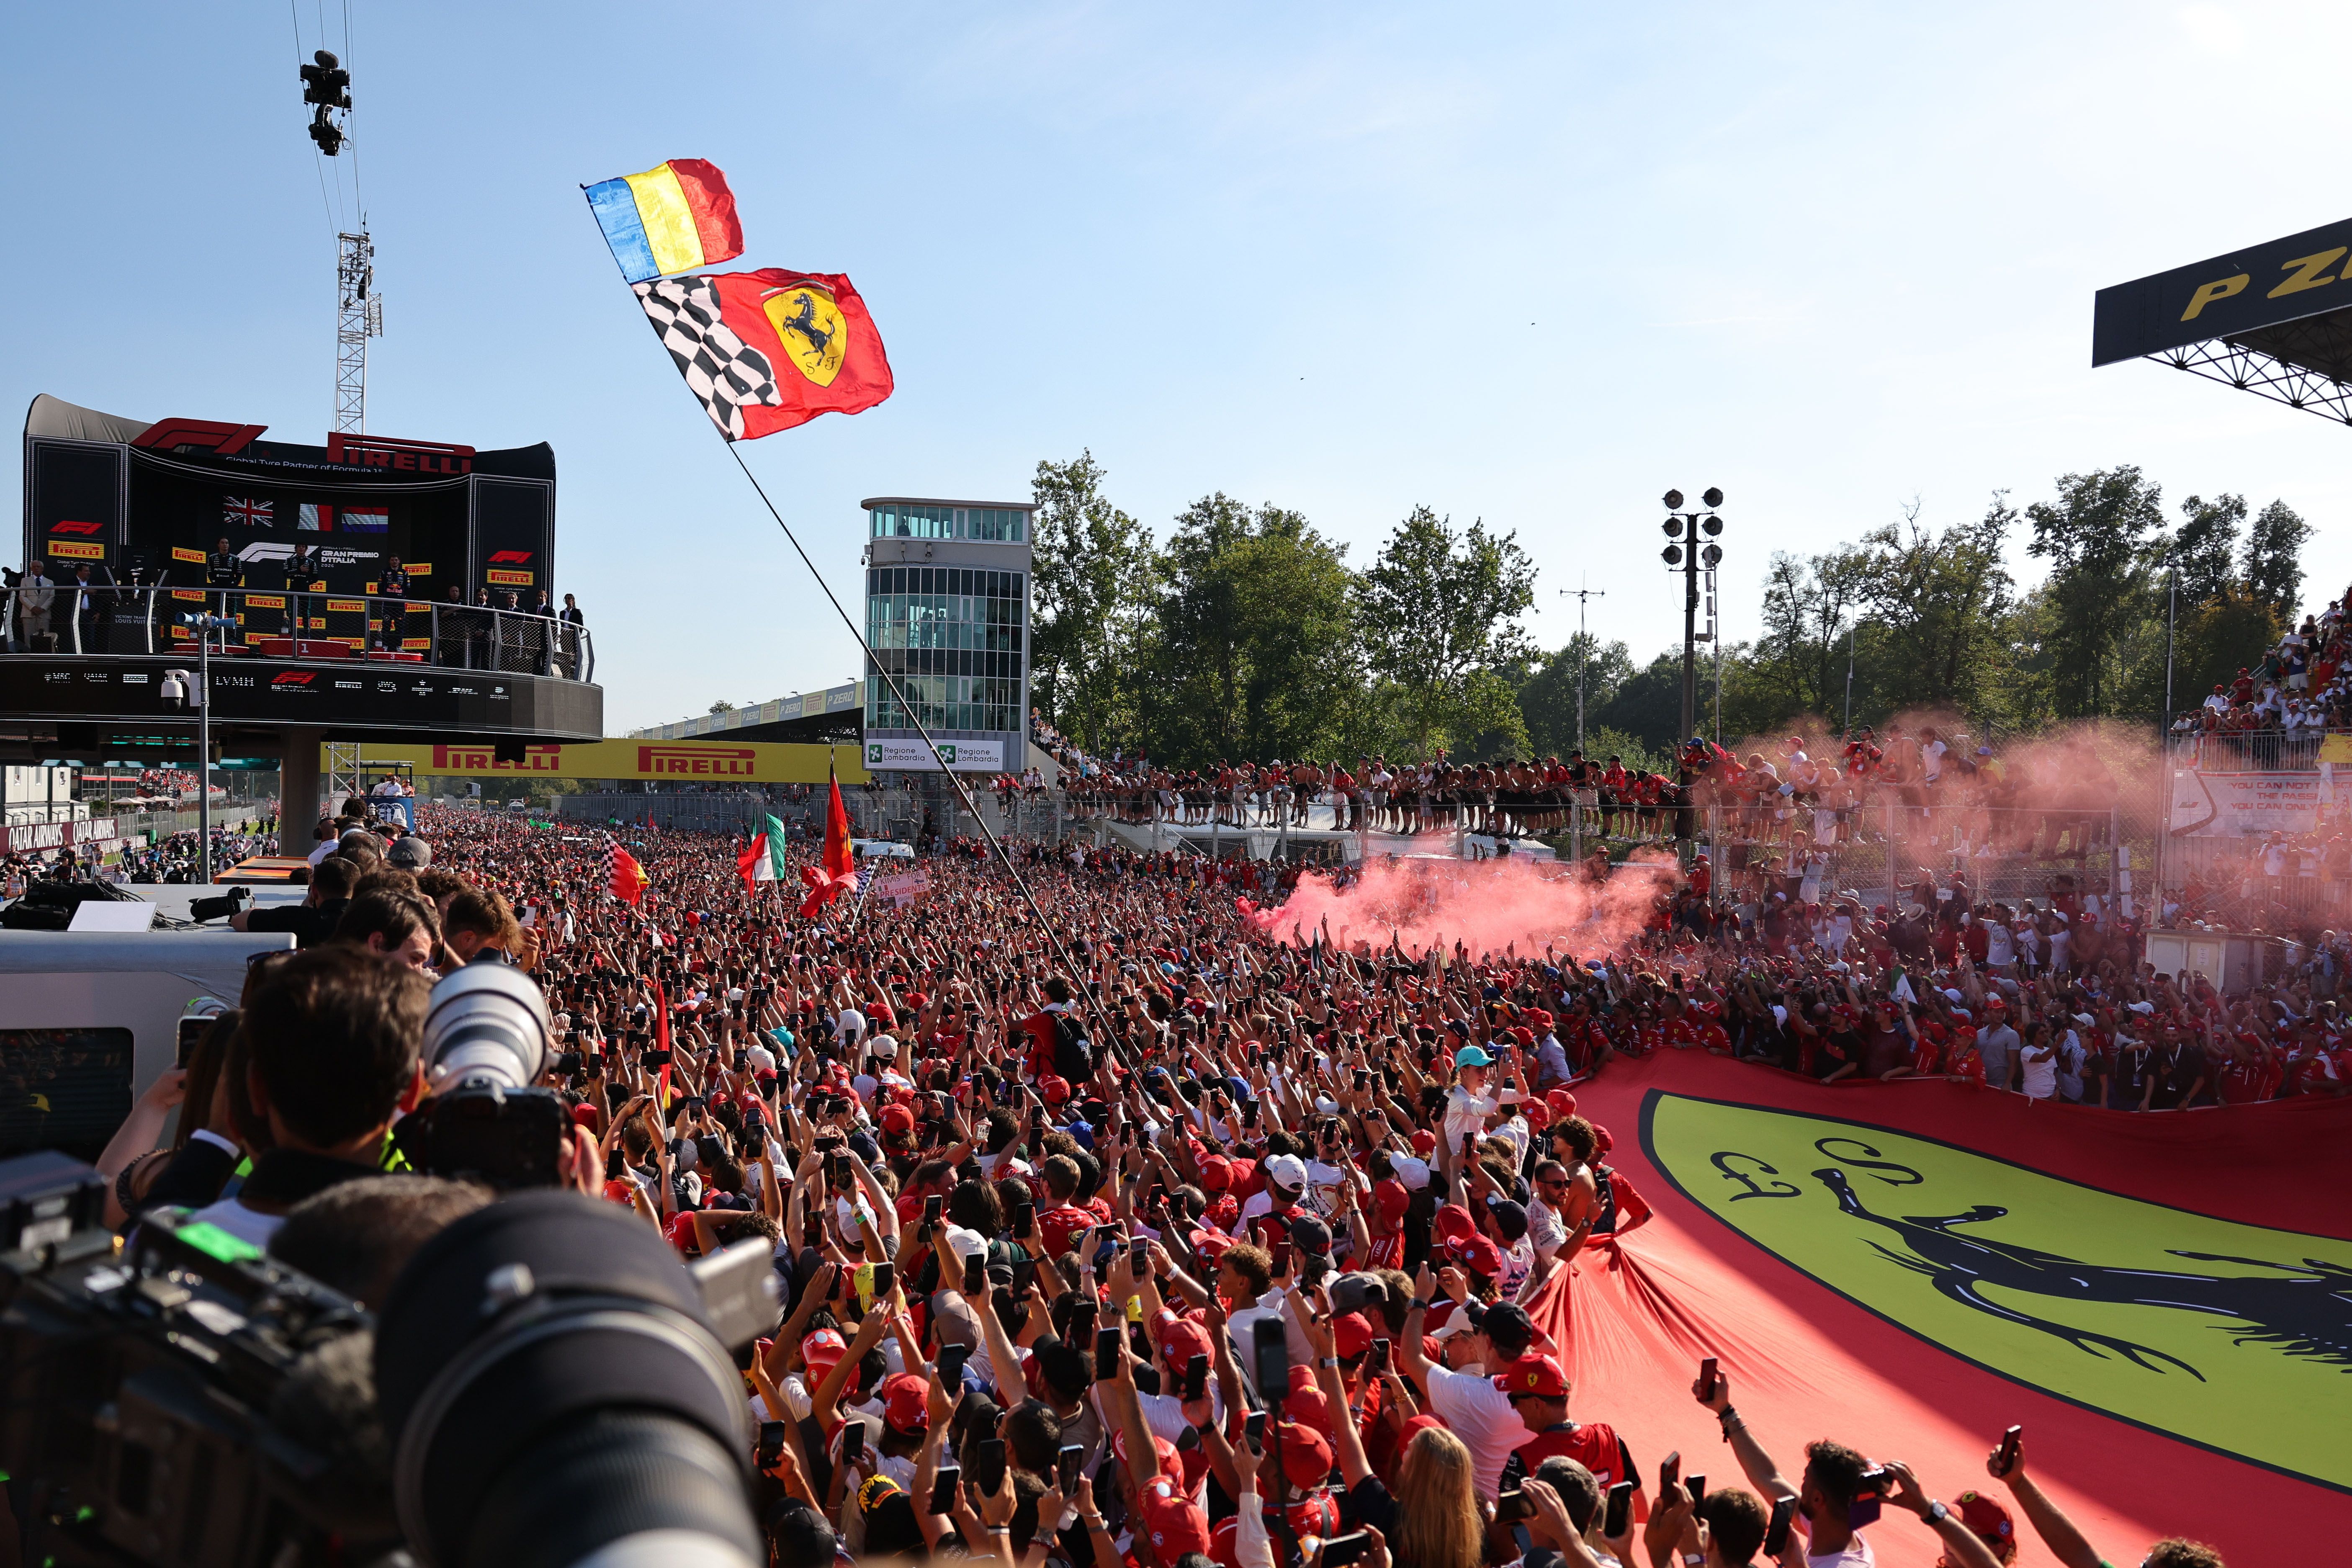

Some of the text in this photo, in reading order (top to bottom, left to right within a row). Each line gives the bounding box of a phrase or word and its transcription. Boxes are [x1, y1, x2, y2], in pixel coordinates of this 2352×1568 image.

[2180, 273, 2250, 322] P
[806, 362, 815, 375] S
[327, 432, 476, 474] PIRELLI
[283, 461, 319, 469] Partner
[53, 544, 99, 556] PIRELLI
[175, 550, 203, 561] PIRELLI
[491, 572, 530, 582] PIRELLI
[249, 597, 282, 607] PIRELLI
[301, 644, 309, 653] 1
[216, 677, 254, 686] LVMH
[806, 694, 822, 712] PIRELLI
[827, 695, 833, 705] P
[834, 691, 854, 704] ZERO
[763, 705, 776, 720] PIRELLI
[785, 702, 801, 713] ZERO
[715, 717, 725, 726] ZERO
[728, 712, 739, 726] PIRELLI
[746, 710, 759, 721] ZERO
[884, 747, 916, 755] Regione
[638, 746, 755, 775] PIRELLI
[9, 824, 63, 851] QATAR AIRWAYS
[73, 819, 115, 844] QATAR AIRWAYS
[880, 875, 900, 884] KIMIS
[880, 884, 926, 898] PRESIDENTS
